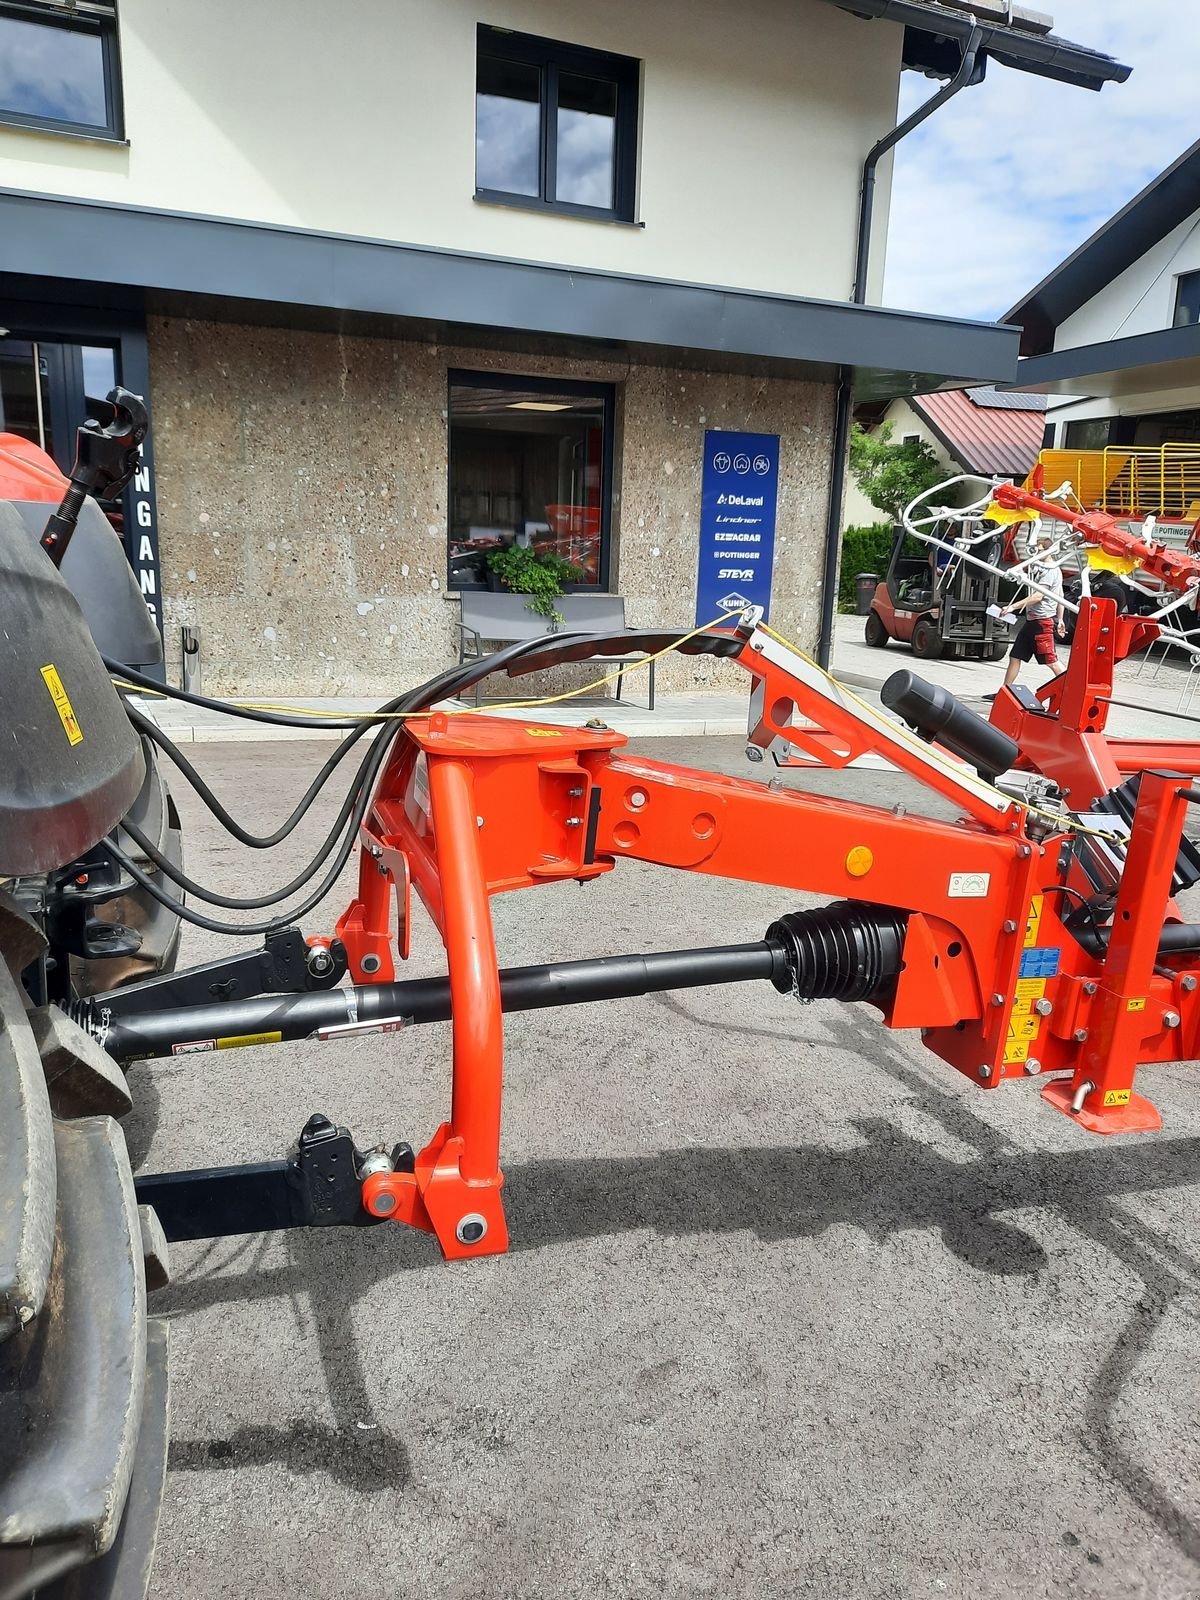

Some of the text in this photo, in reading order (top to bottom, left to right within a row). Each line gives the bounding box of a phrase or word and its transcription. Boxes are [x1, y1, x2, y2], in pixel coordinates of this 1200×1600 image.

[728, 494, 764, 506] DeLaval
[135, 395, 157, 625] NGAN
[715, 515, 761, 523] Lindner
[717, 569, 754, 578] STEYR
[722, 599, 745, 607] KUHN
